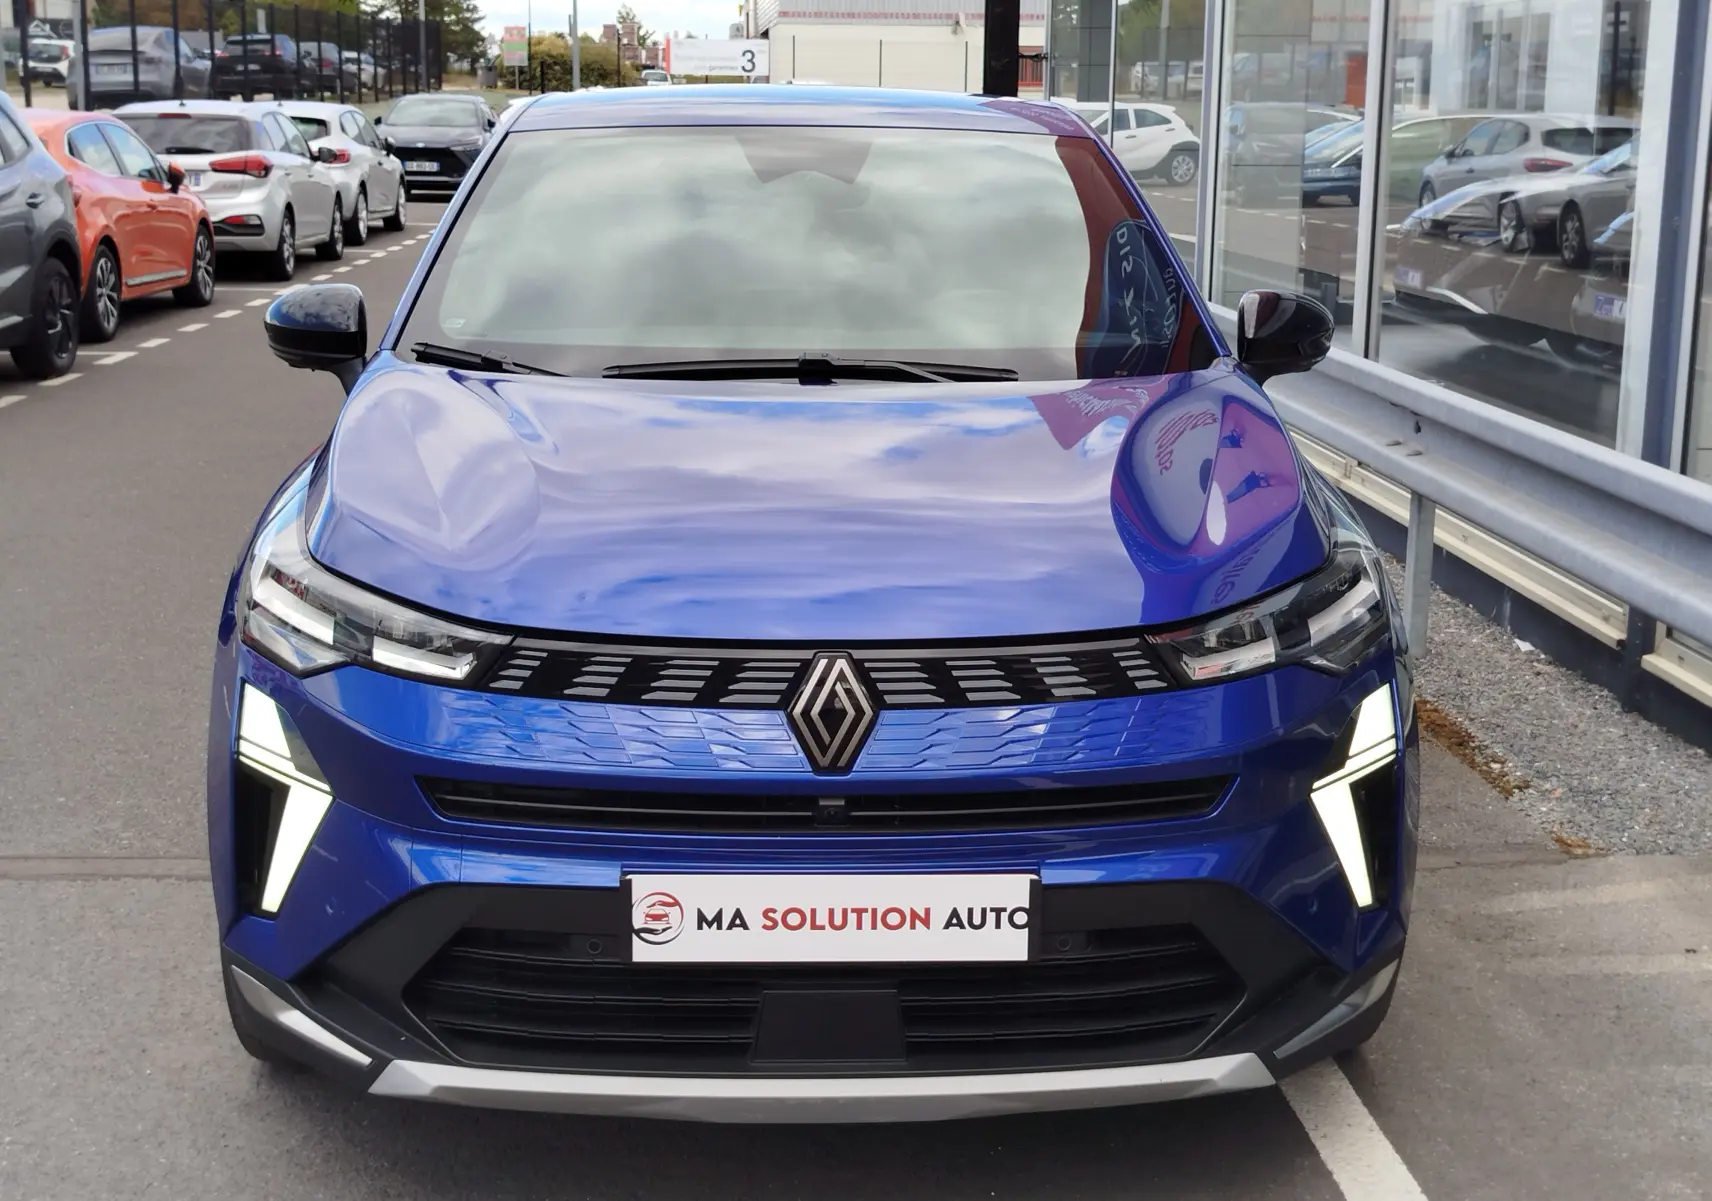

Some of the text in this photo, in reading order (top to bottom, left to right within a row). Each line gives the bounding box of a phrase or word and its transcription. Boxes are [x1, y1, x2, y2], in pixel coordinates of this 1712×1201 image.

[741, 49, 756, 73] 3
[696, 906, 1030, 931] MA SOLUTION AUTO
